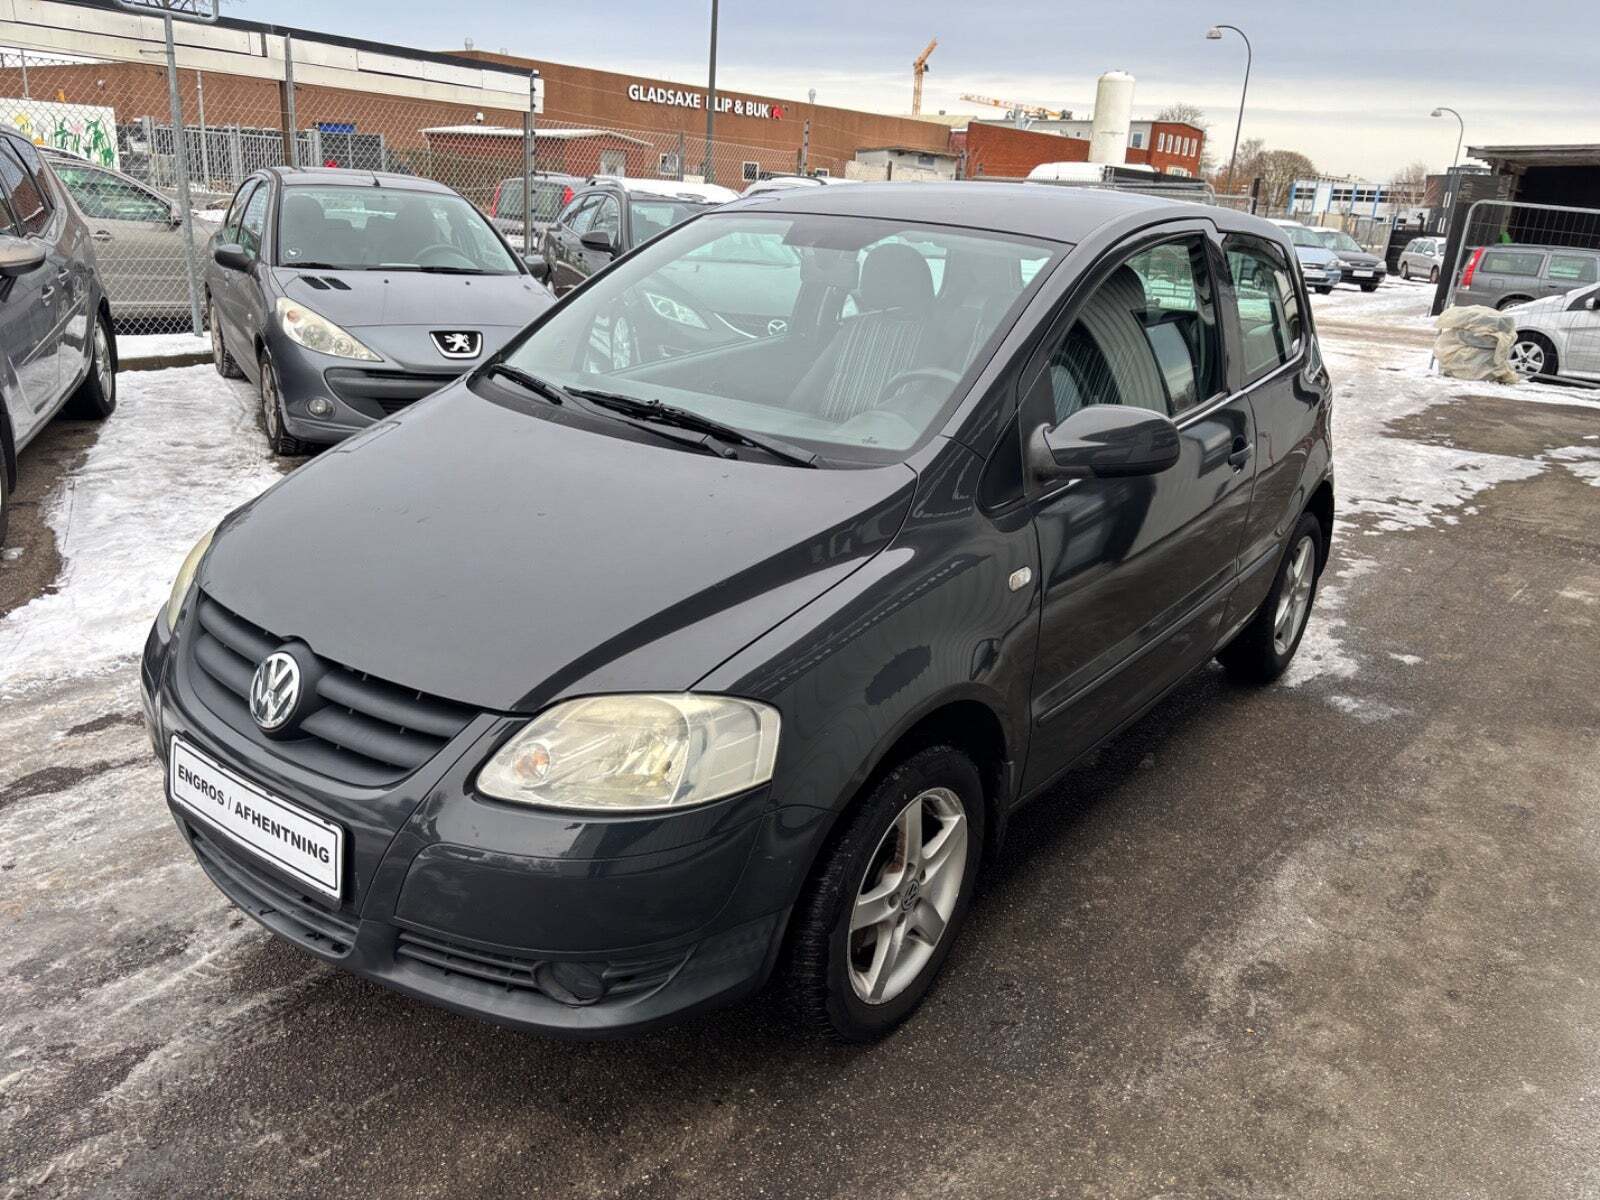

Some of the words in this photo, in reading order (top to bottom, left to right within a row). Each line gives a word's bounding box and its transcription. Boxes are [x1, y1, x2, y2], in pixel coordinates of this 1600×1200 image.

[629, 84, 700, 109] GLADSAXE
[706, 95, 732, 113] LIP
[734, 99, 743, 114] &
[746, 101, 769, 118] BUK
[178, 764, 225, 806] ENGROS
[234, 803, 330, 863] AFHENTNING
